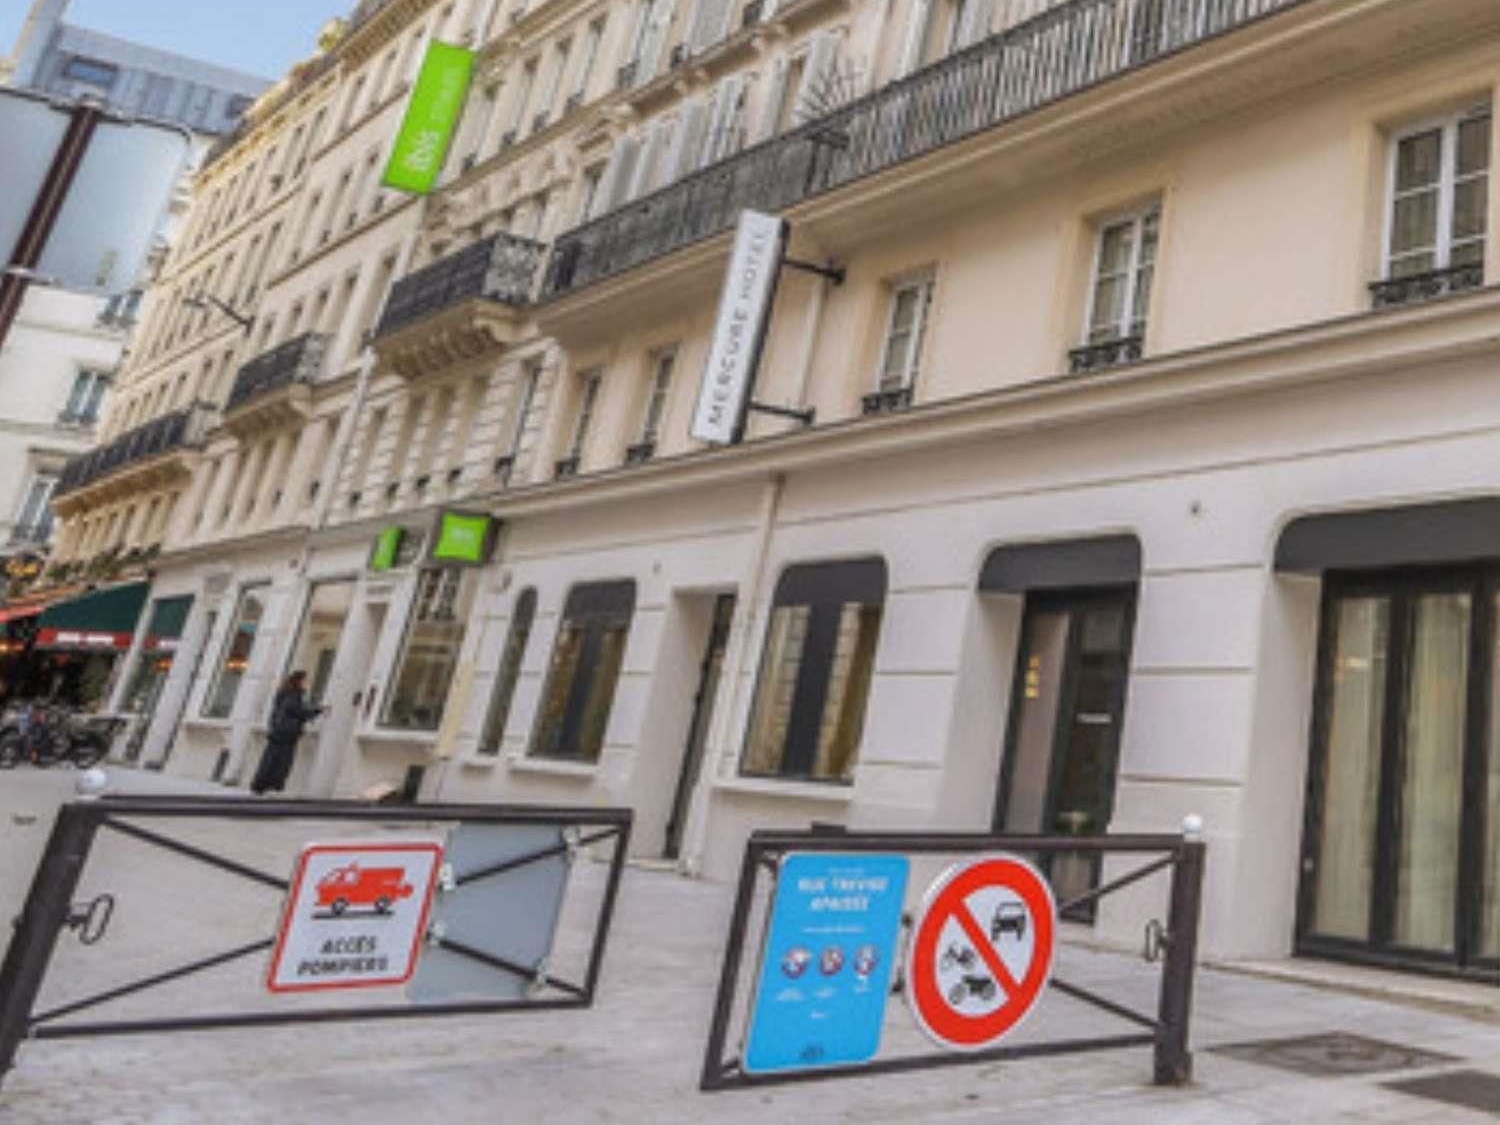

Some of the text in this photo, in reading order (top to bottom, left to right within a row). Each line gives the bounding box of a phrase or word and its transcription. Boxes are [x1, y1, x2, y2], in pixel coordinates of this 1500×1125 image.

[707, 232, 767, 426] MERCURE HOTEL
[298, 957, 389, 975] POMPIERS
